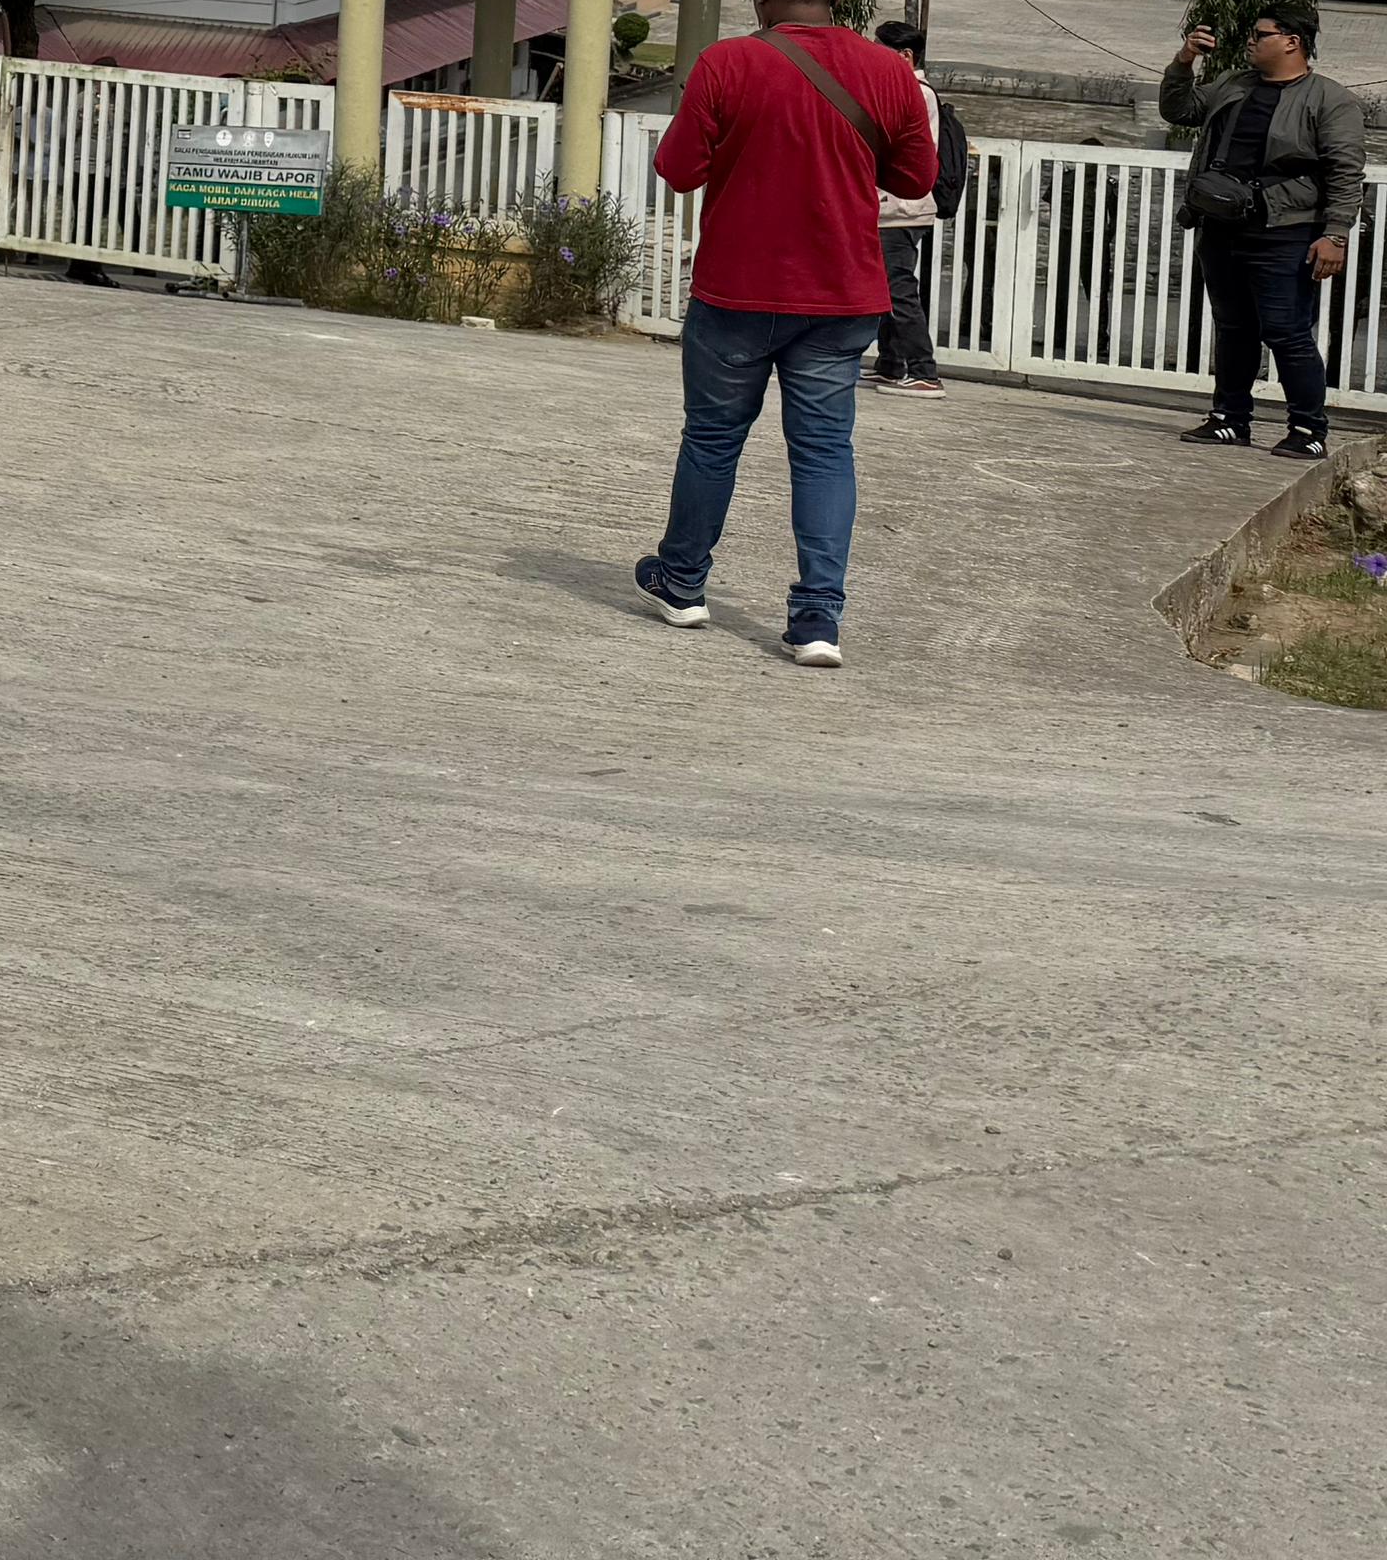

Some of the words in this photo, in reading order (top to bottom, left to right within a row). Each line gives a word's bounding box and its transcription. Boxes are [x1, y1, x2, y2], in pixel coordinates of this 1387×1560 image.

[176, 165, 214, 179] TAMU
[218, 168, 262, 181] WAJIB
[267, 171, 315, 184] LAPOR
[169, 183, 196, 193] KACA
[199, 184, 231, 195] MOBIL
[234, 186, 255, 196] DAN
[258, 188, 286, 198] KACA
[203, 195, 237, 206] HARAP
[240, 198, 280, 208] DIBUKA
